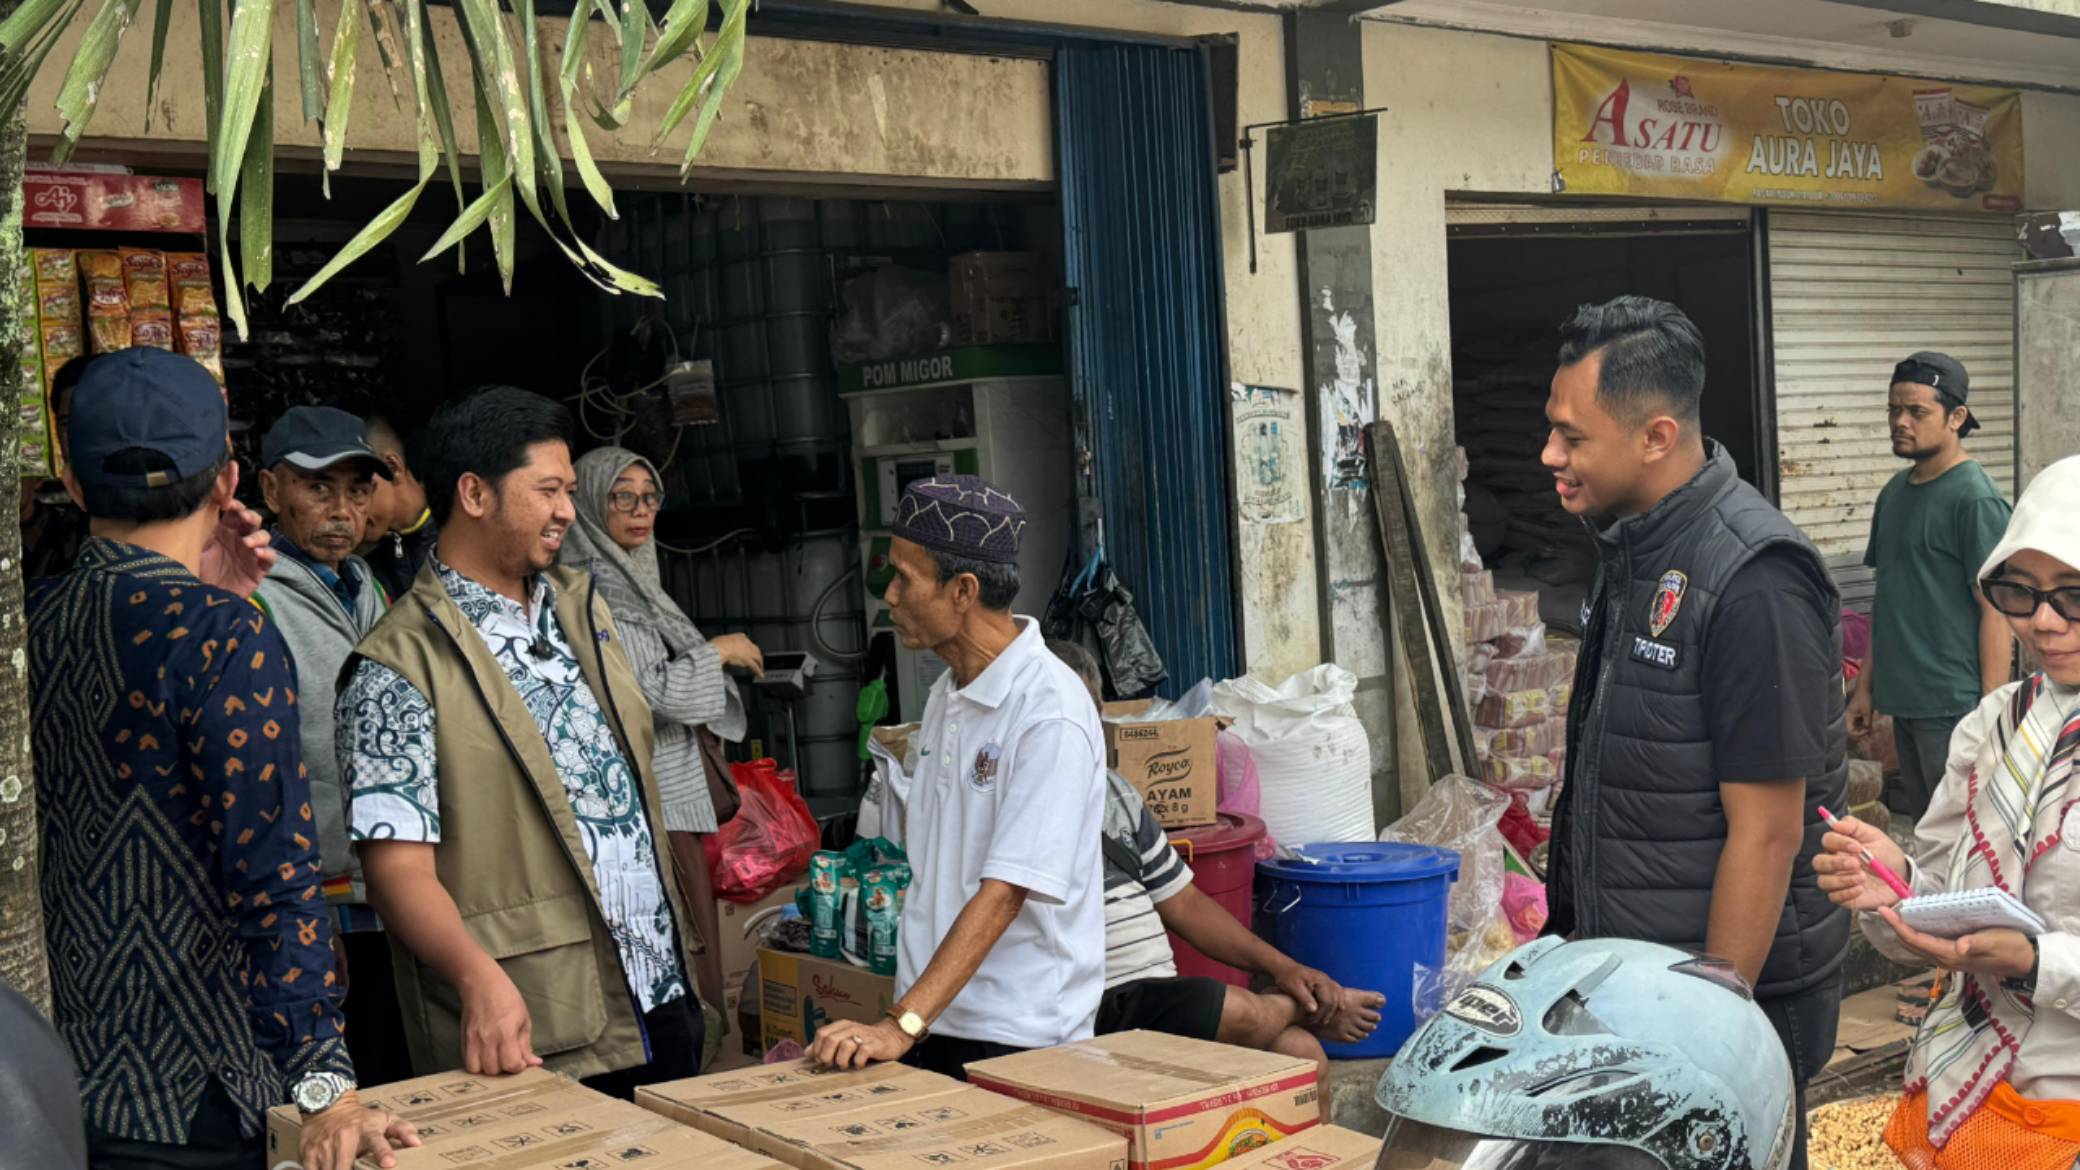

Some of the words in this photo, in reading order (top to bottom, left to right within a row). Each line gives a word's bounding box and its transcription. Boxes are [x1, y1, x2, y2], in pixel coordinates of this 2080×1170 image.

[1775, 96, 1851, 136] TOKO
[1670, 156, 1715, 174] RASA
[1746, 134, 1819, 177] AURA
[1825, 140, 1884, 181] JAYA
[863, 363, 896, 387] POM
[901, 356, 953, 382] MIGOR
[1146, 759, 1190, 779] Royco
[1147, 787, 1191, 801] AYAM
